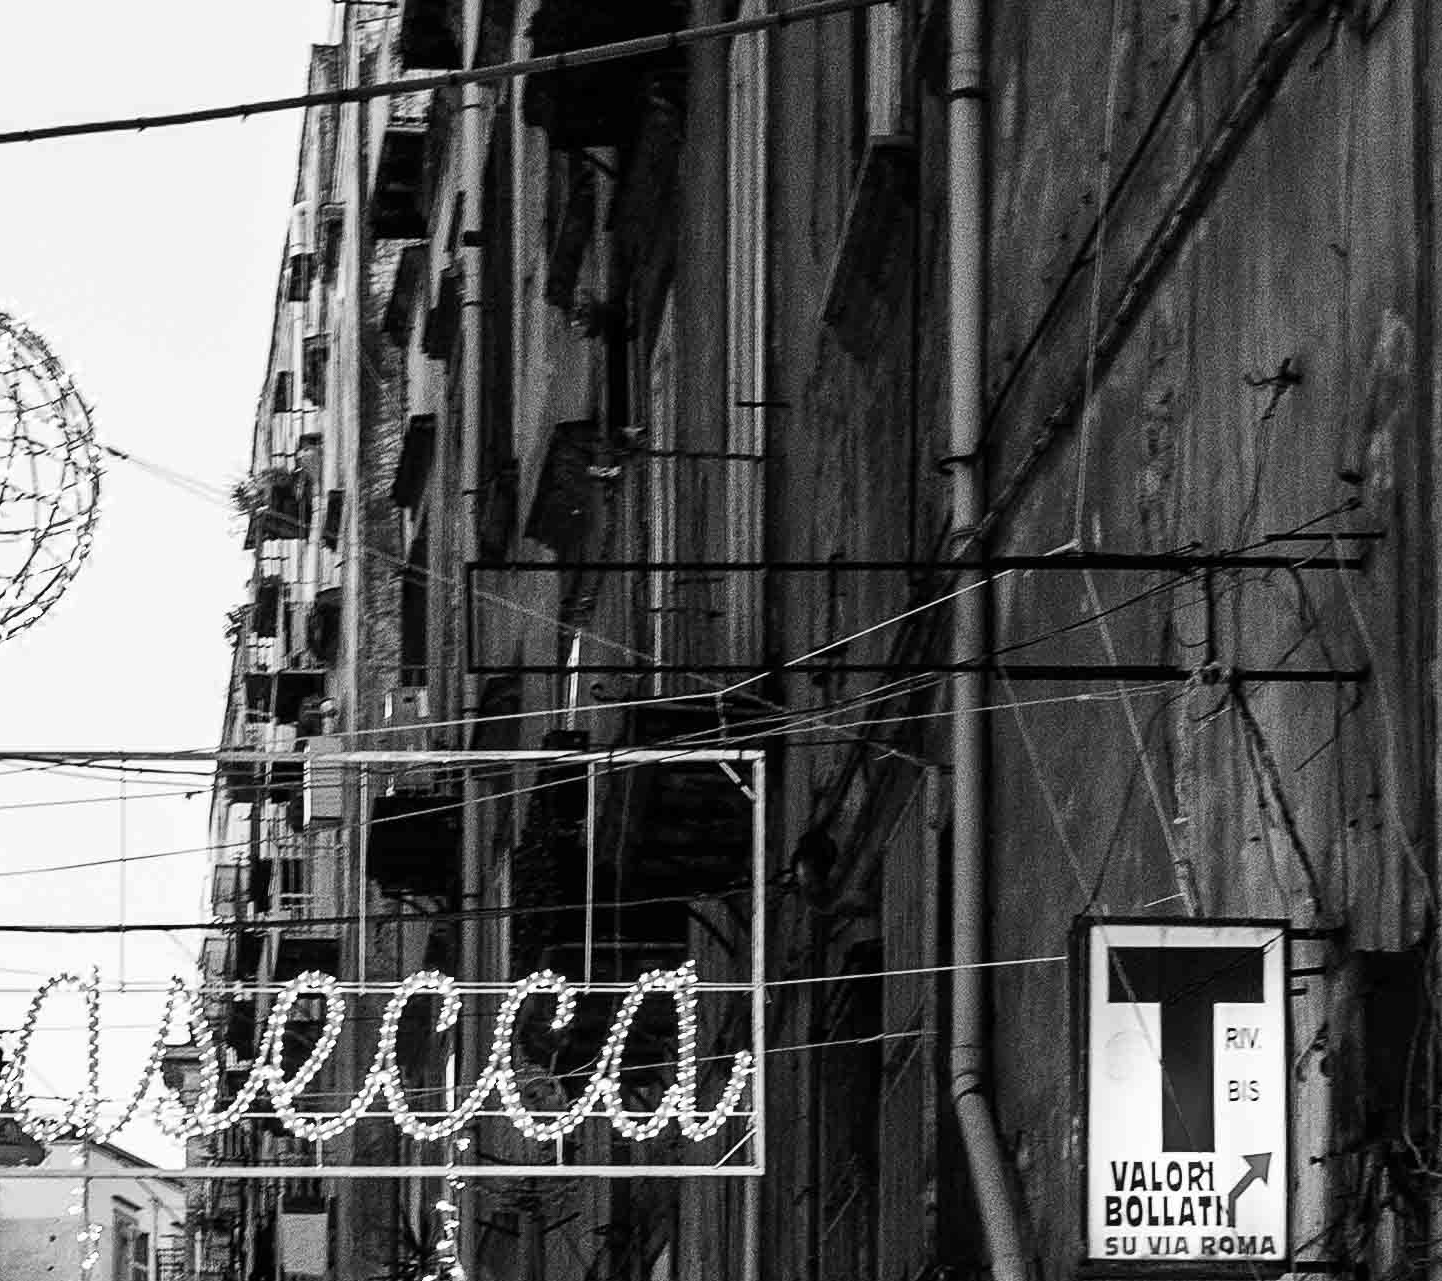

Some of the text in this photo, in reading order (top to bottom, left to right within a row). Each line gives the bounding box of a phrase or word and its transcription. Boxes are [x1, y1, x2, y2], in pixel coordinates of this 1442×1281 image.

[1110, 1160, 1217, 1193] VALORI
[1105, 1235, 1277, 1257] SU VIA ROMA
